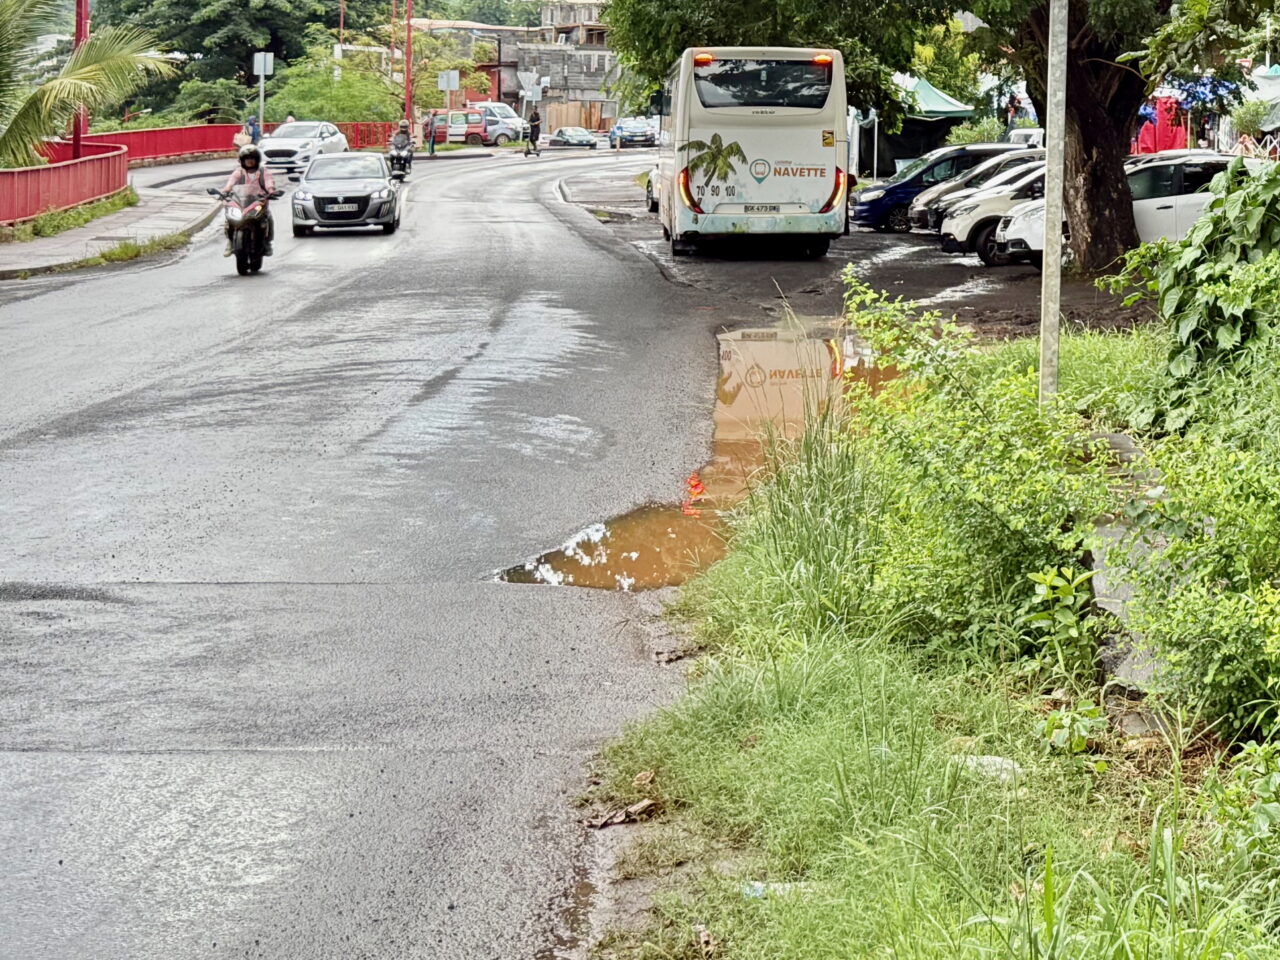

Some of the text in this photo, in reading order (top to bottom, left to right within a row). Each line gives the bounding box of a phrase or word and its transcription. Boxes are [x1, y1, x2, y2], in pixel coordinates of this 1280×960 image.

[773, 167, 826, 178] NAVETTE
[696, 185, 735, 196] 70 90 100
